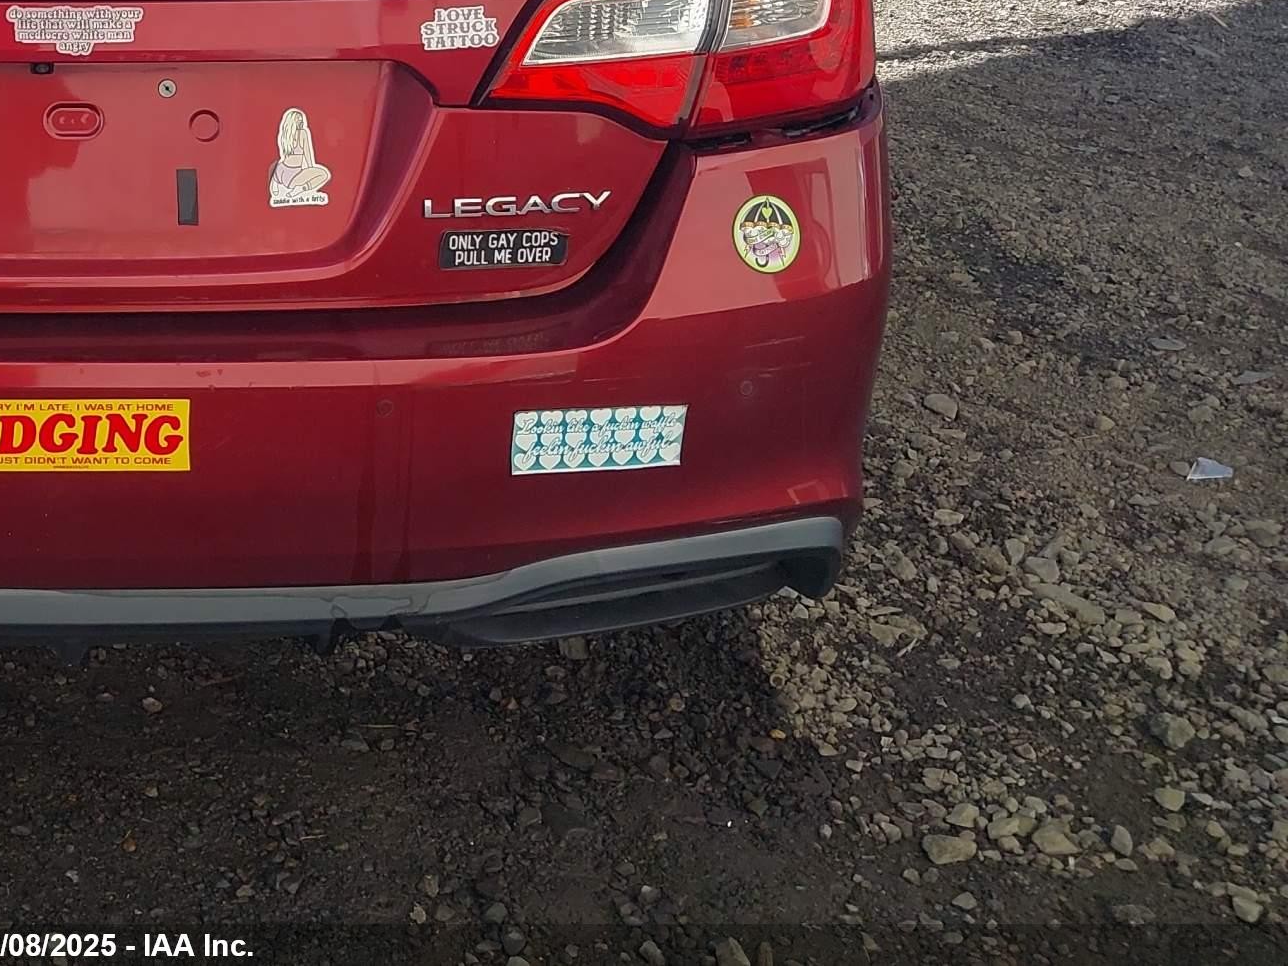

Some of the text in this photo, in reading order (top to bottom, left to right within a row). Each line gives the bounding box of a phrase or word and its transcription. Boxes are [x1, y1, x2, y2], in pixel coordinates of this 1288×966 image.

[9, 8, 140, 21] do something with your
[436, 8, 482, 22] LOVE
[18, 20, 132, 30] life that will make a
[423, 20, 495, 36] STRUCK
[18, 30, 131, 40] mediocre white man
[424, 33, 498, 48] TATTOO
[58, 42, 91, 53] angry
[424, 190, 612, 219] LEGACY
[449, 232, 559, 251] ONLY GAY COPS
[455, 247, 552, 266] PULL ME OVER
[40, 404, 72, 412] LATE,
[516, 418, 563, 434] Lookin
[566, 417, 589, 434] like
[598, 414, 640, 437] fuckin
[641, 412, 677, 434] waffle
[522, 431, 673, 464] feelin fuckin awful
[24, 457, 67, 465] DIDN'T
[71, 457, 110, 465] WANT
[114, 457, 130, 465] TO
[134, 457, 172, 465] COME
